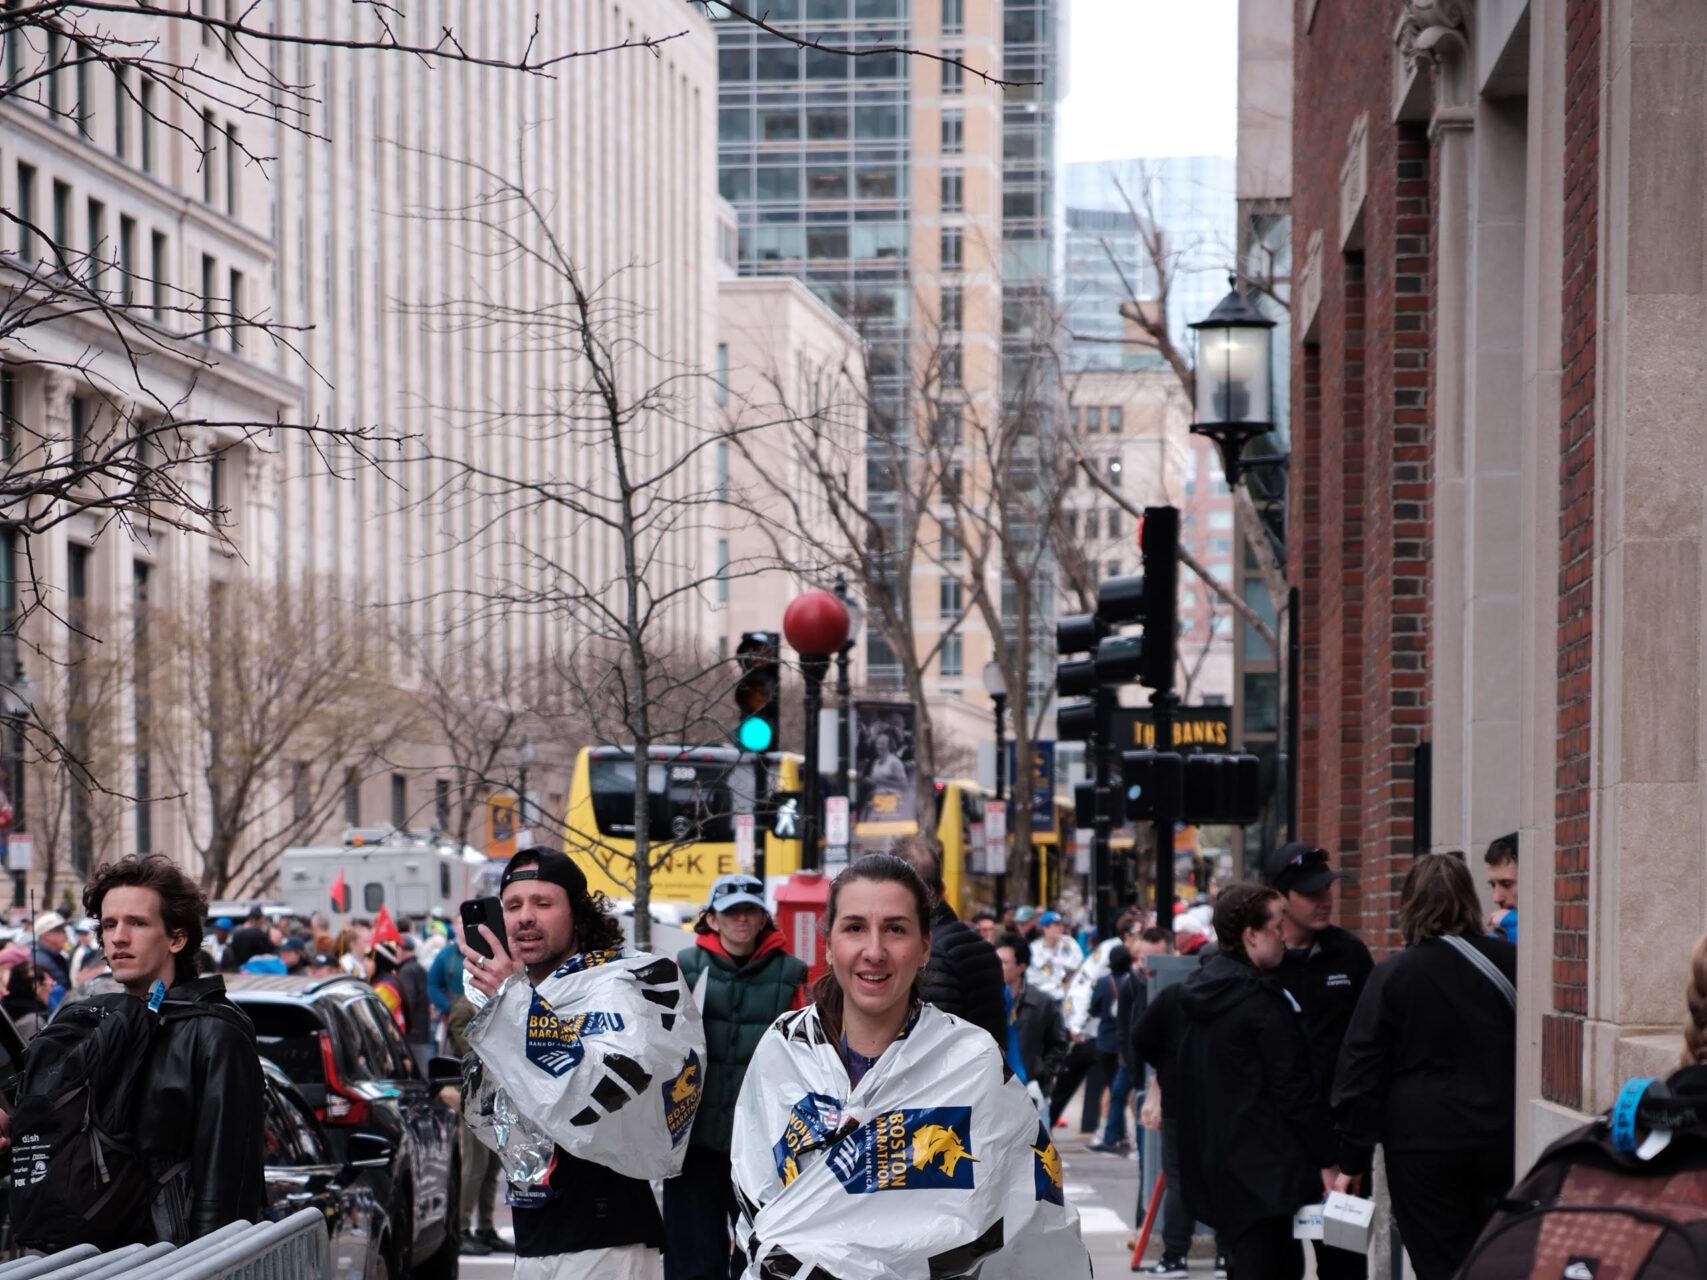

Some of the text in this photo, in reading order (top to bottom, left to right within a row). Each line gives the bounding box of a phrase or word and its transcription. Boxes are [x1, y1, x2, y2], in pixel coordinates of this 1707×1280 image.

[1134, 721, 1227, 746] TH BANKS
[529, 1015, 559, 1028] BOS
[876, 1116, 889, 1189] MARATHON
[889, 1112, 907, 1187] BOSTON
[865, 1152, 873, 1190] AMERICA
